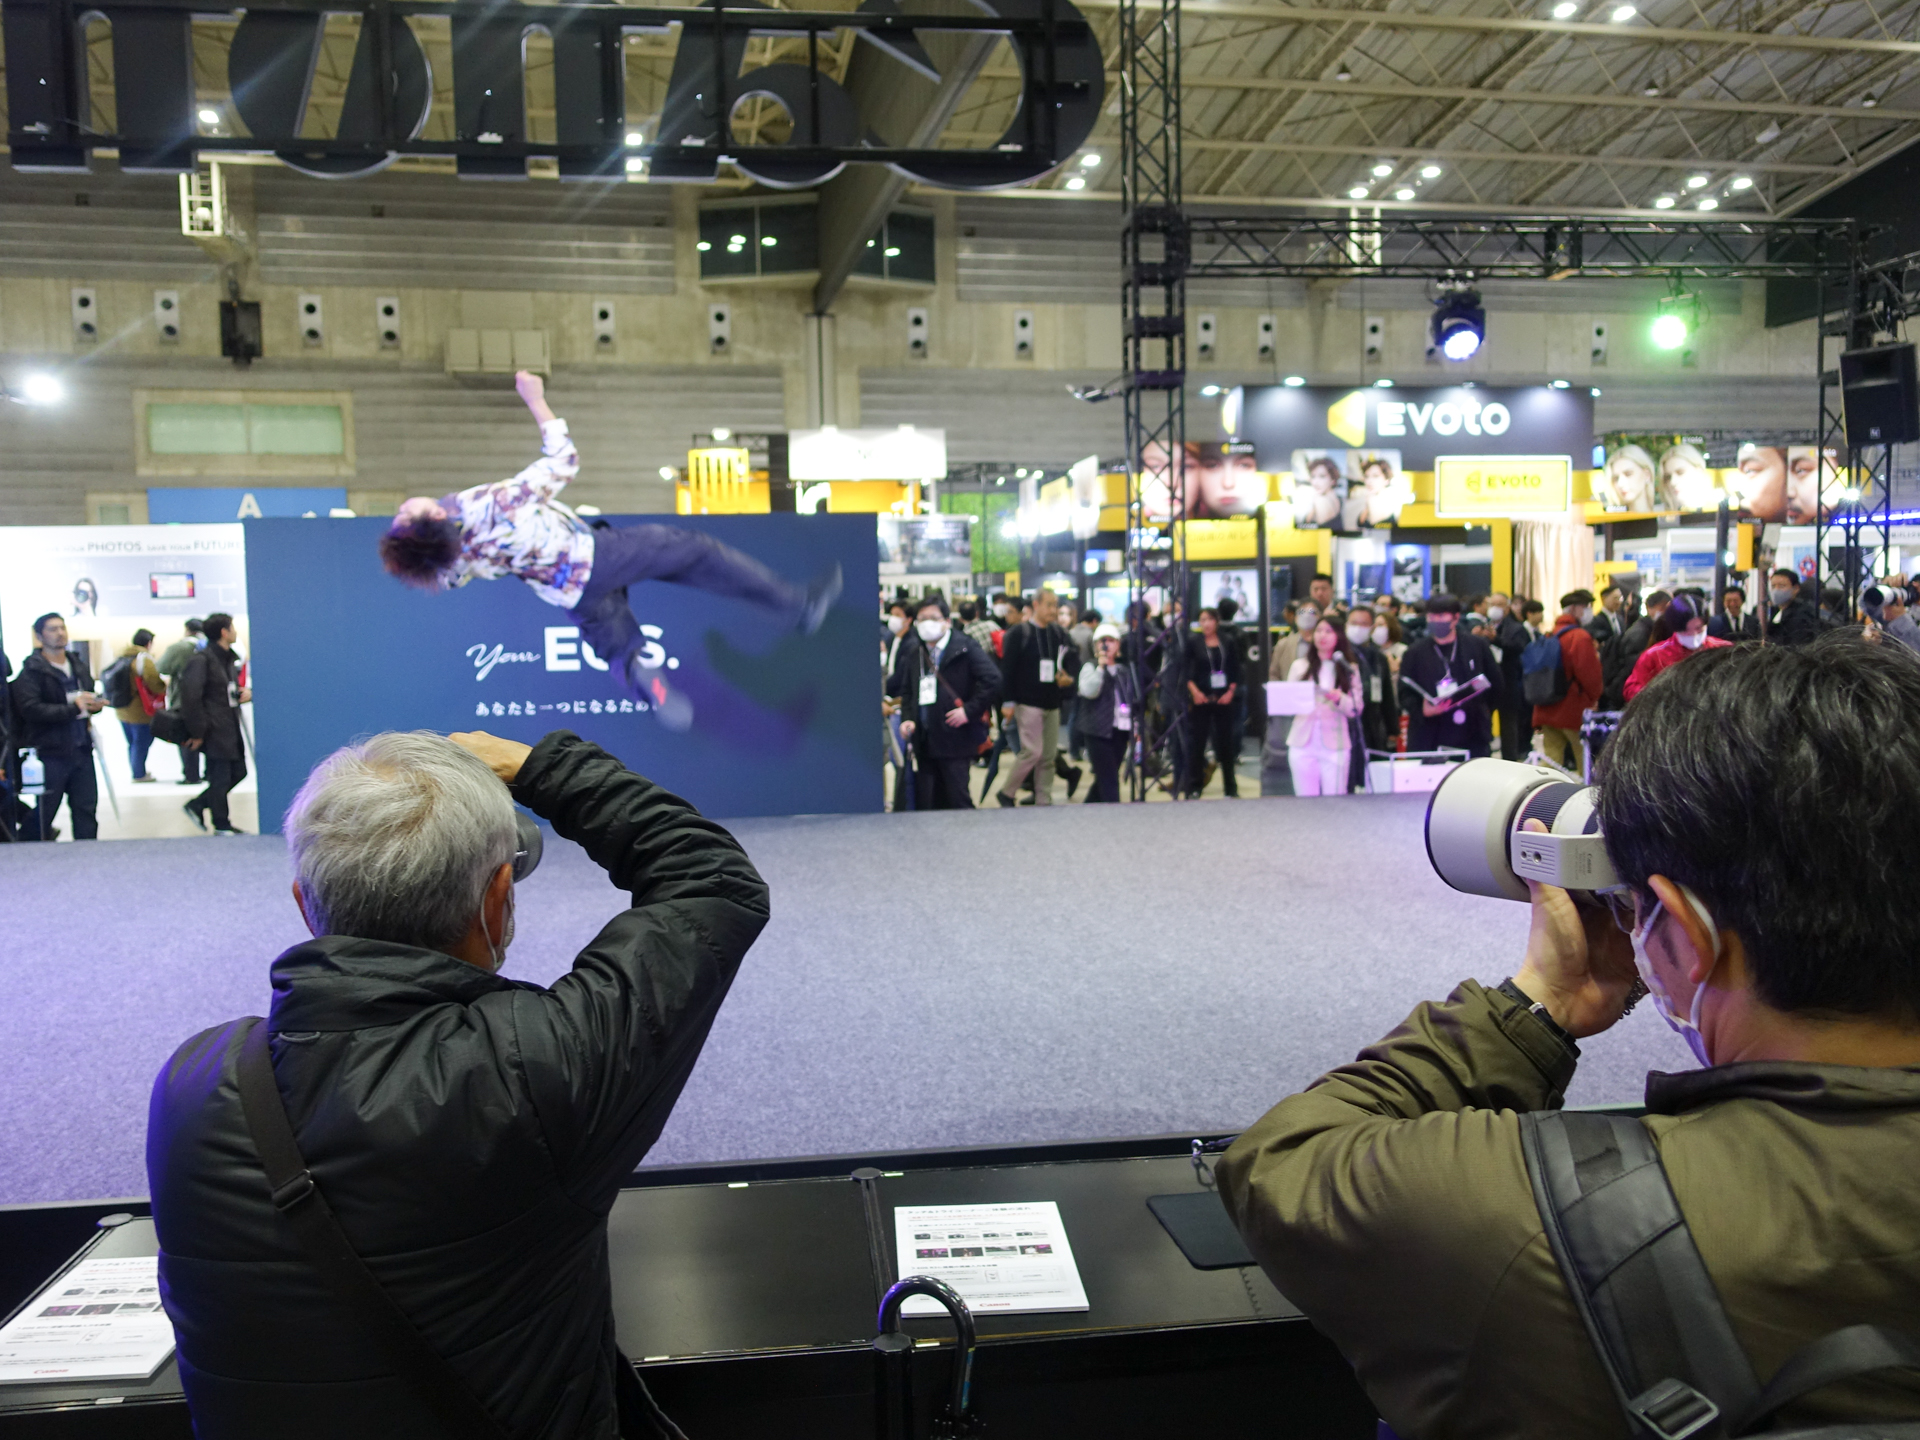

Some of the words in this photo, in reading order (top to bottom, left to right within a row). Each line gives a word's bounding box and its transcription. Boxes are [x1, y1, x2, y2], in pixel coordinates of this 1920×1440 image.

[236, 493, 263, 519] A
[465, 642, 542, 683] Your
[475, 697, 658, 717] あなたと一つになるため
